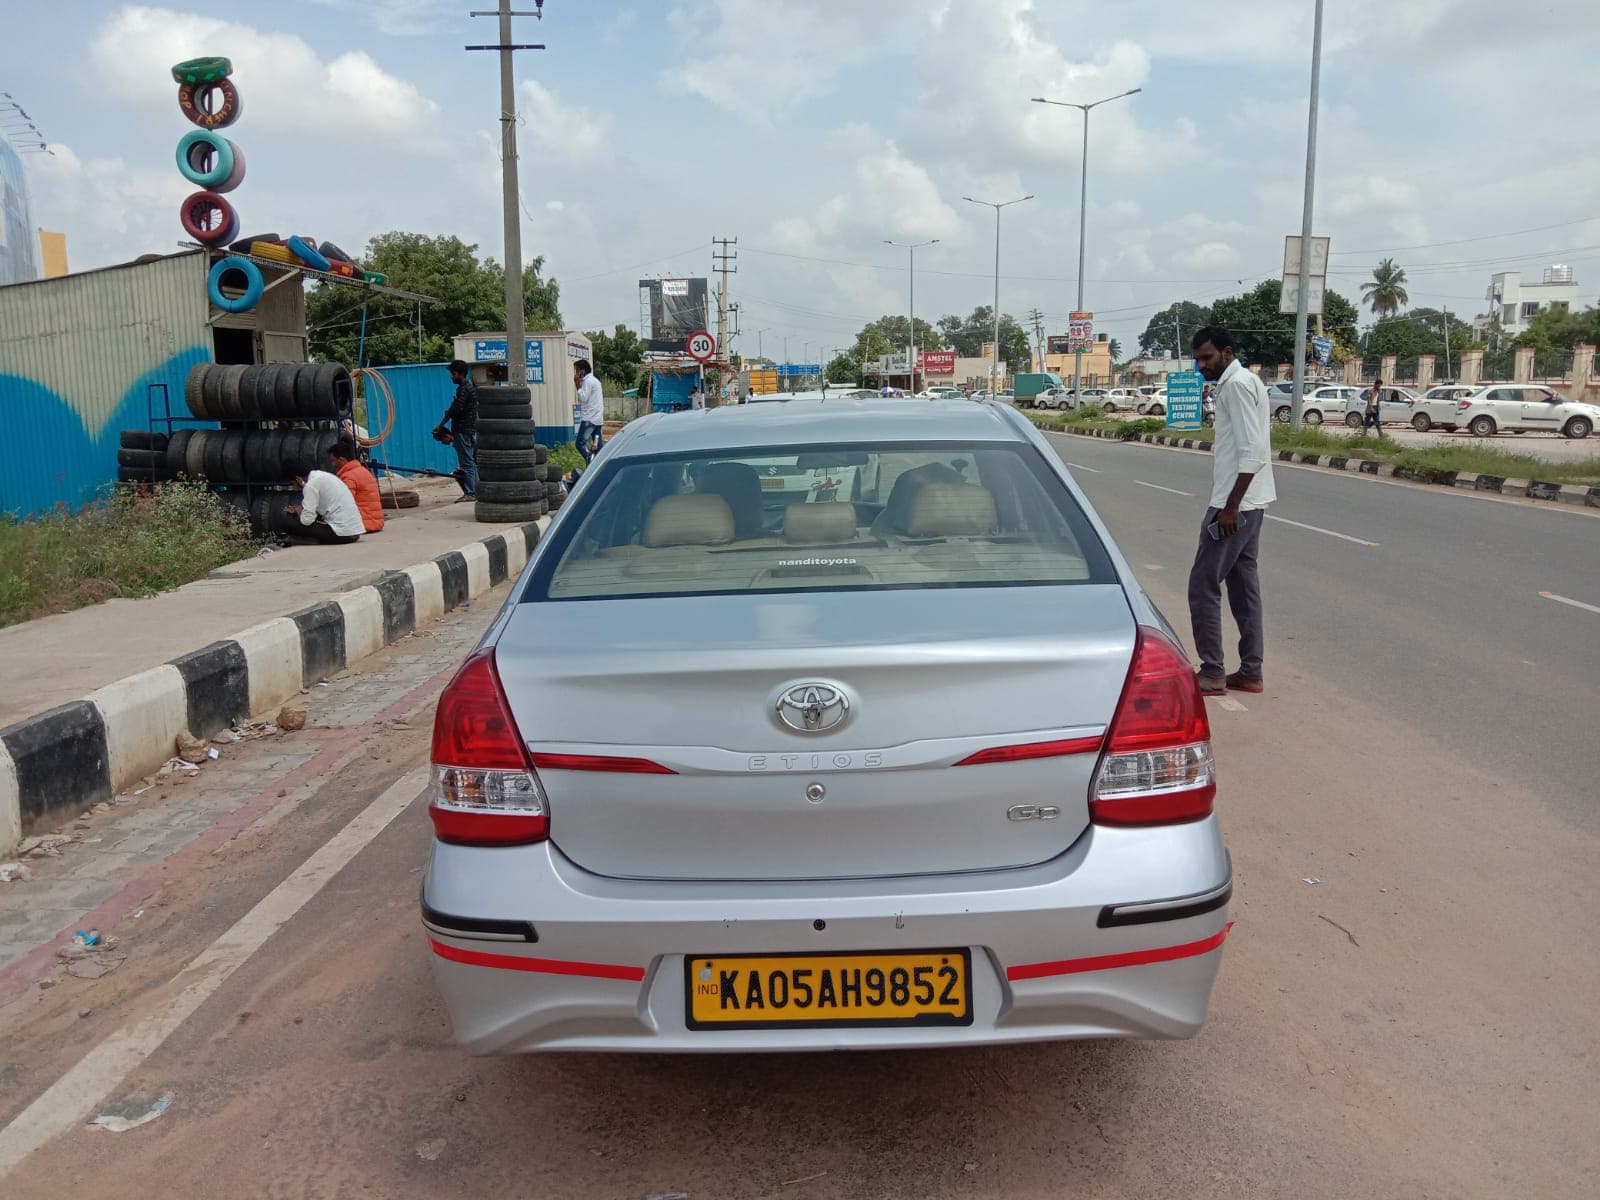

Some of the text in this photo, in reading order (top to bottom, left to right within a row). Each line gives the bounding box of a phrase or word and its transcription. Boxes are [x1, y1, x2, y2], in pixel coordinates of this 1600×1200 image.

[692, 339, 709, 352] 30
[926, 355, 952, 363] AMSTEL
[1169, 395, 1201, 403] EMISSION
[1171, 403, 1198, 411] TESTING
[1172, 411, 1196, 419] CENTRE
[778, 556, 858, 567] nanditoyota
[747, 752, 883, 771] ETIOS
[697, 965, 960, 1010] IND KA05AH9852
